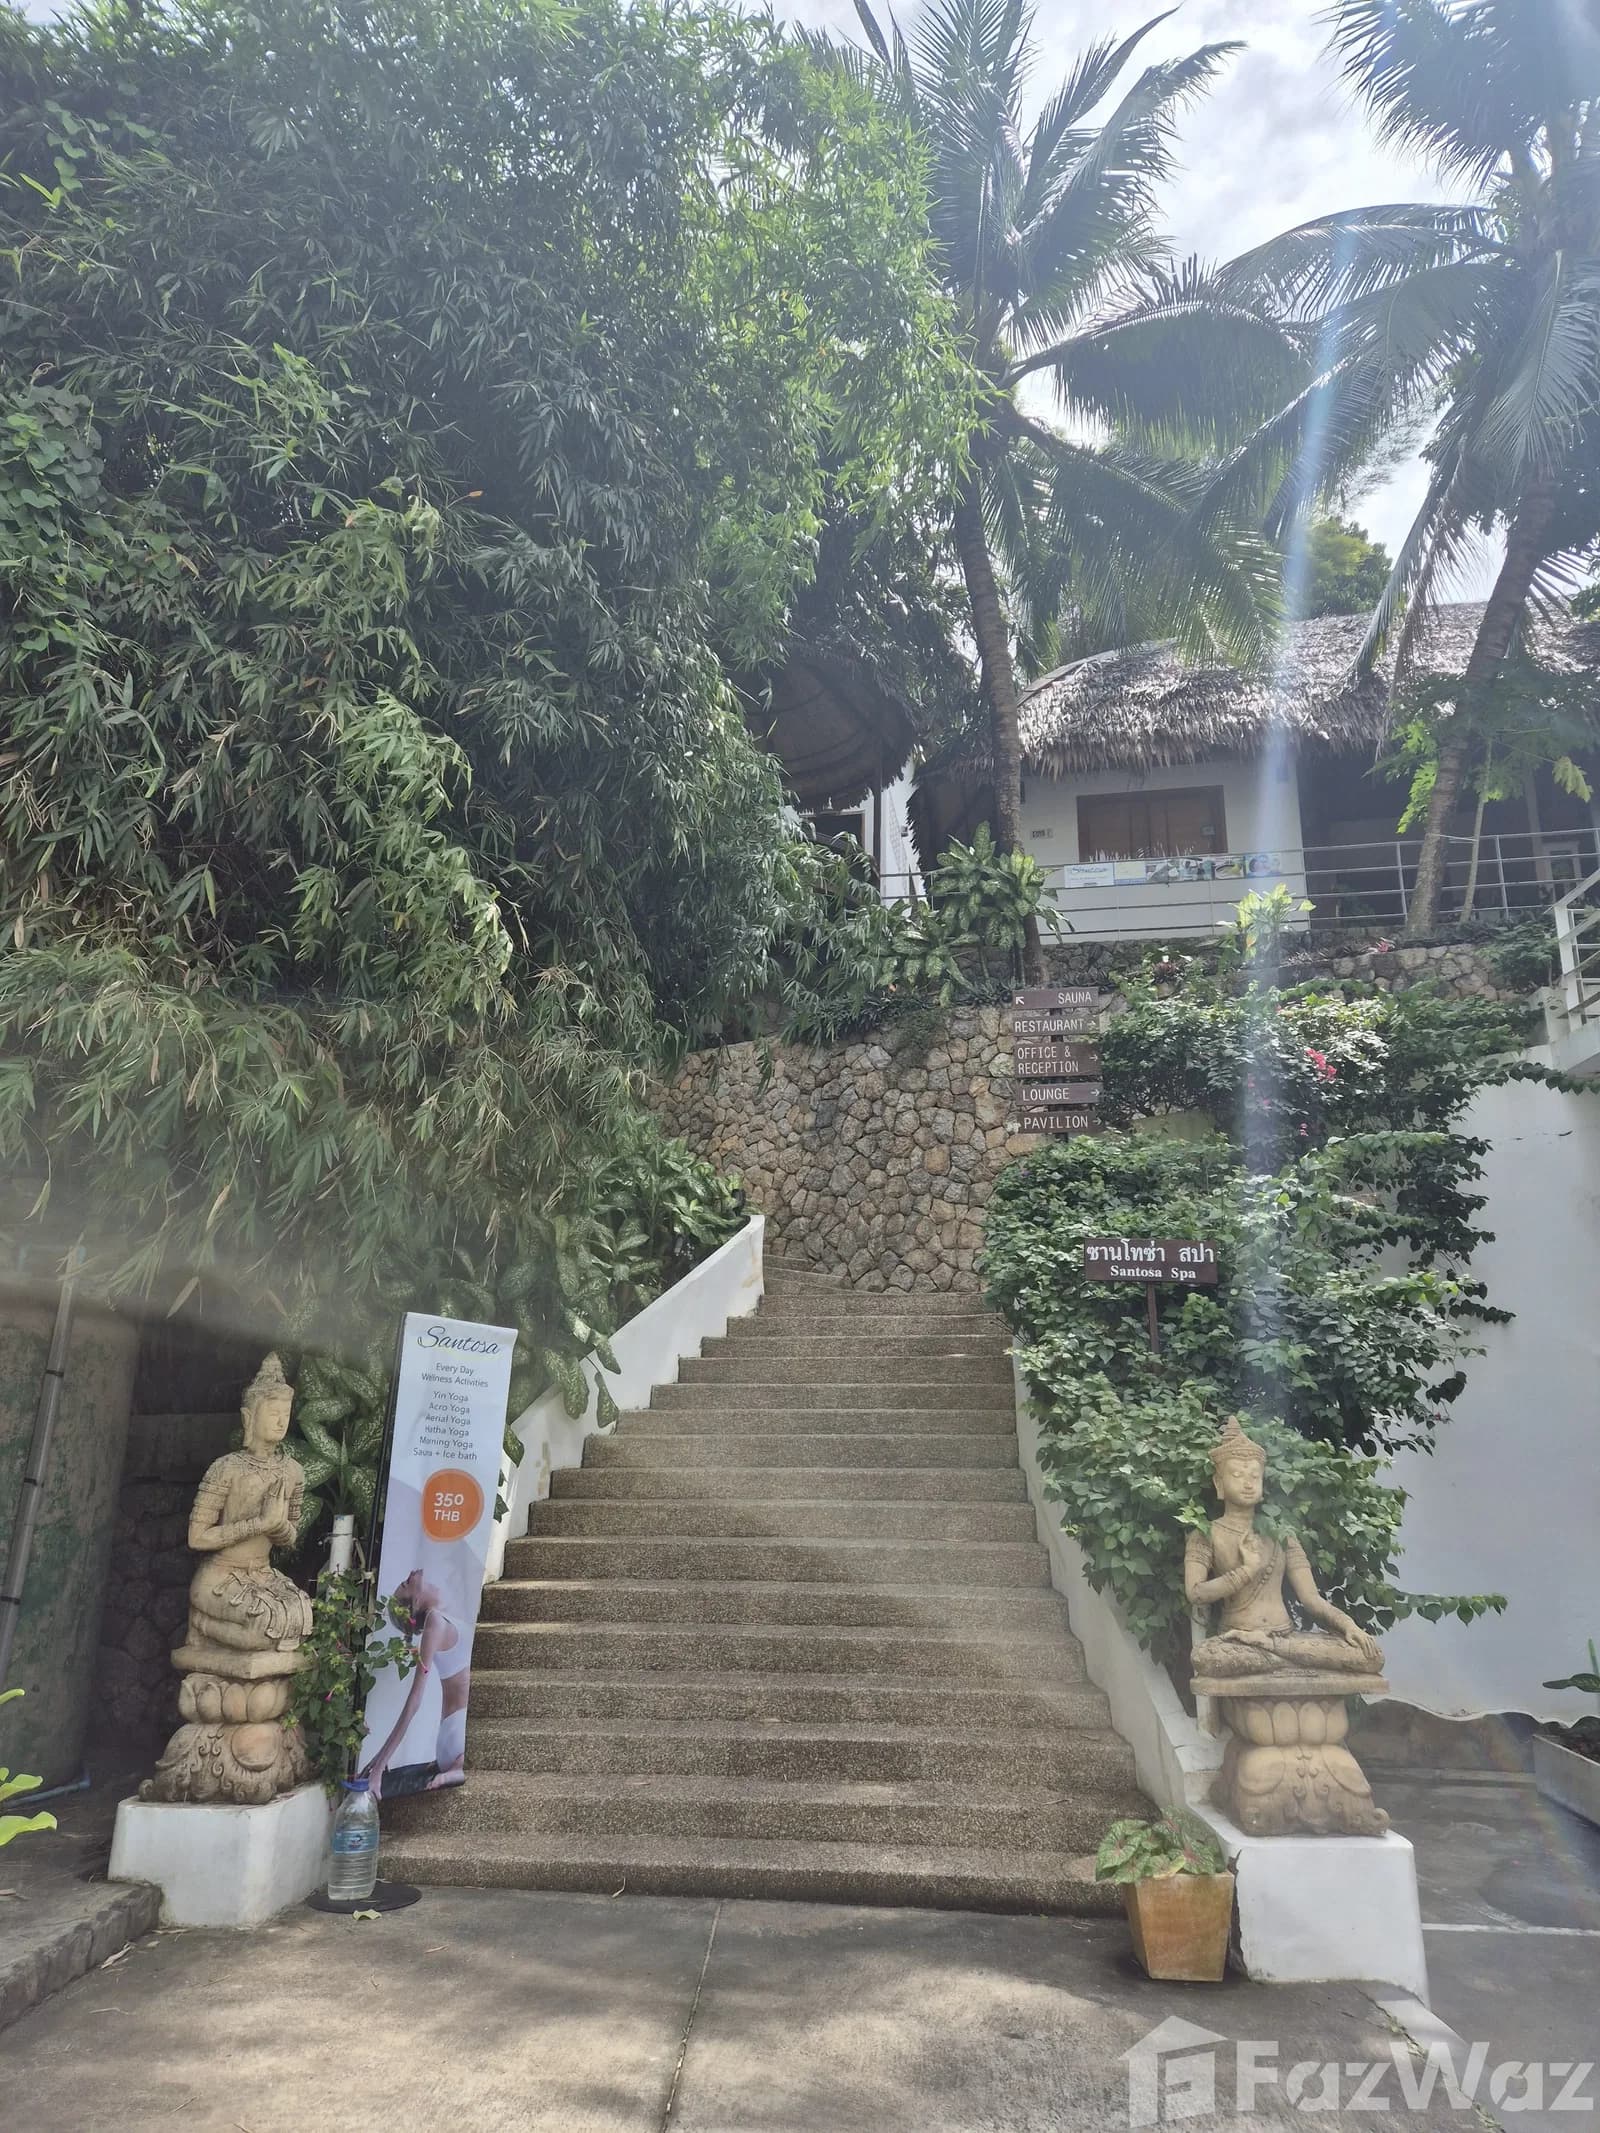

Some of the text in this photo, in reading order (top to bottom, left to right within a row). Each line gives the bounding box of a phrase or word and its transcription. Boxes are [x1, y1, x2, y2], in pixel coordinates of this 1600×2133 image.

[1058, 991, 1092, 1005] SAUNA
[1015, 1018, 1084, 1033] RESTAURANT
[1017, 1045, 1071, 1059] OFFICE &
[1018, 1061, 1079, 1074] RECEPTION
[1022, 1088, 1069, 1101] LOUNGE
[1023, 1115, 1089, 1129] PAVILION
[1178, 1243, 1214, 1263] สปา
[1110, 1265, 1196, 1280] Santosa Spa
[417, 1325, 501, 1354] Santosa
[435, 1362, 474, 1377] Every Day
[454, 1376, 489, 1388] Activities
[432, 1391, 469, 1403] Yin Yoga
[429, 1402, 470, 1415] Acro Yoga
[425, 1413, 471, 1427] Aerial Yoga
[448, 1427, 470, 1438] Yoga
[452, 1439, 473, 1450] Yoga
[442, 1450, 455, 1459] Ice
[458, 1450, 478, 1460] bath
[433, 1492, 464, 1507] 350
[433, 1509, 460, 1522] THB
